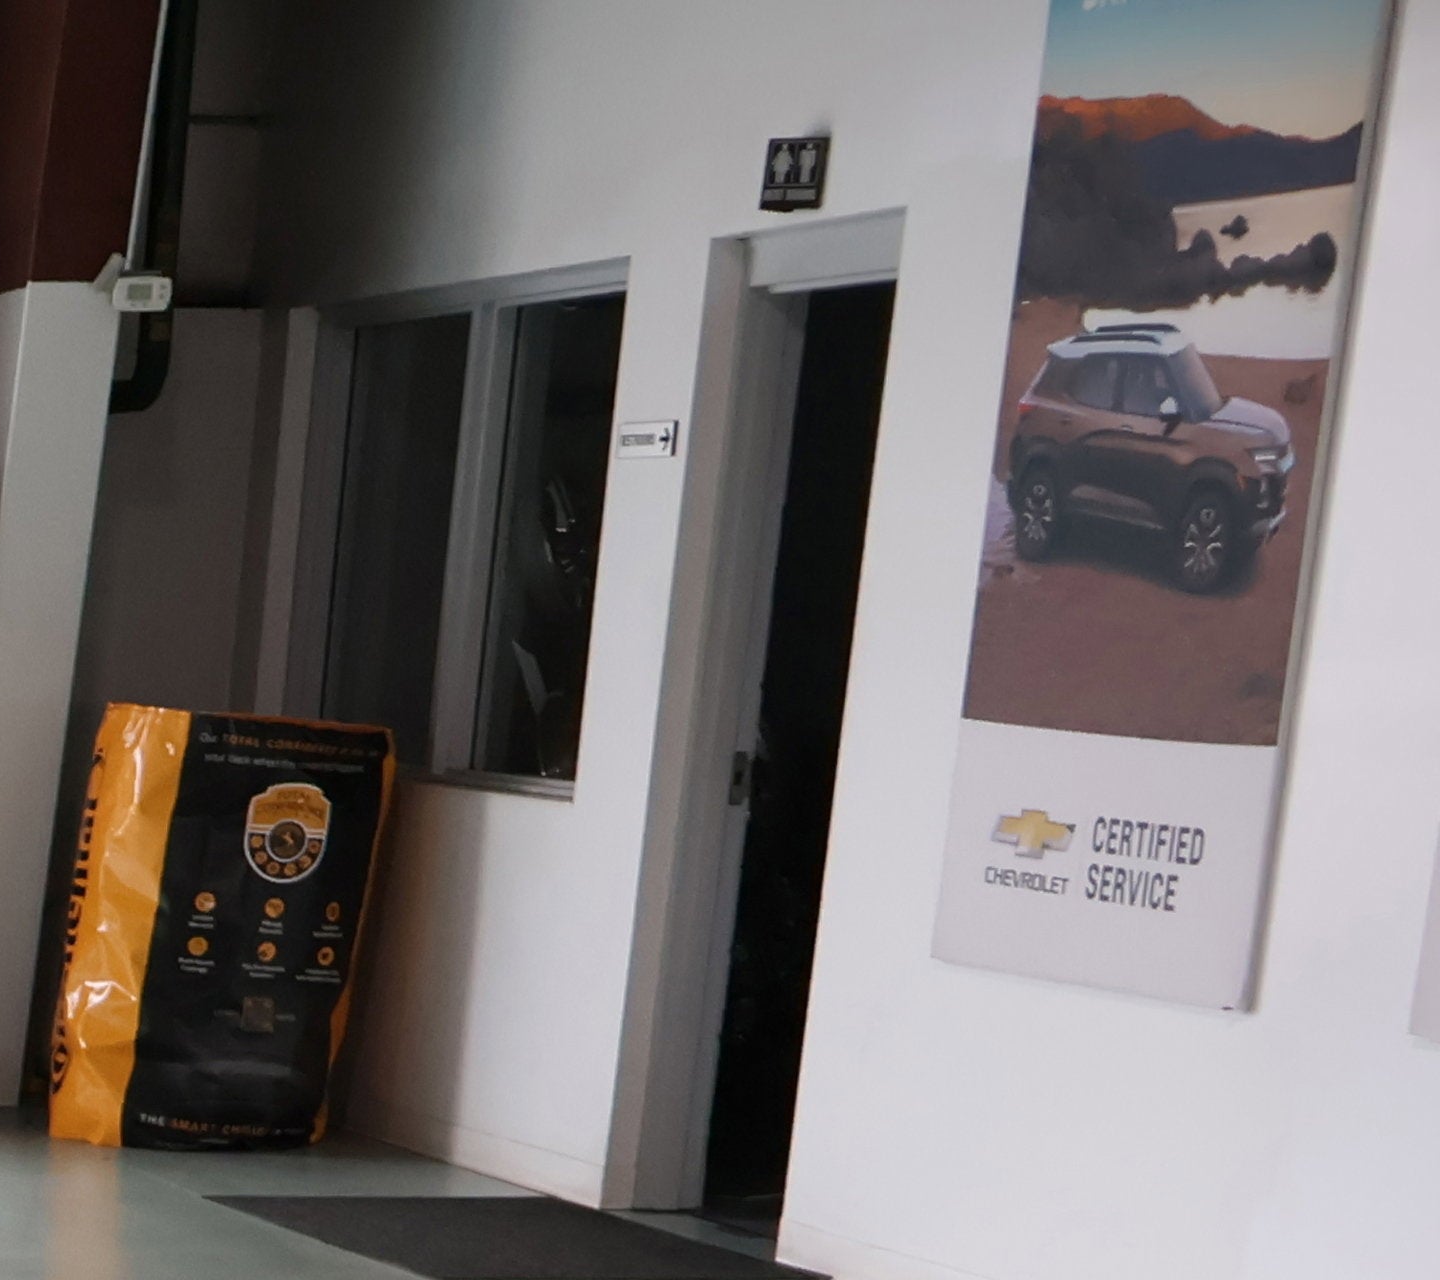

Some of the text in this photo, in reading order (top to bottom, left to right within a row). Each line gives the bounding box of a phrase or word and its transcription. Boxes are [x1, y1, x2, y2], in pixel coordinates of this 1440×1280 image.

[1092, 816, 1205, 865] CERTIFIED
[984, 865, 1069, 896] CHEVROLET
[1085, 865, 1179, 912] SERVICE
